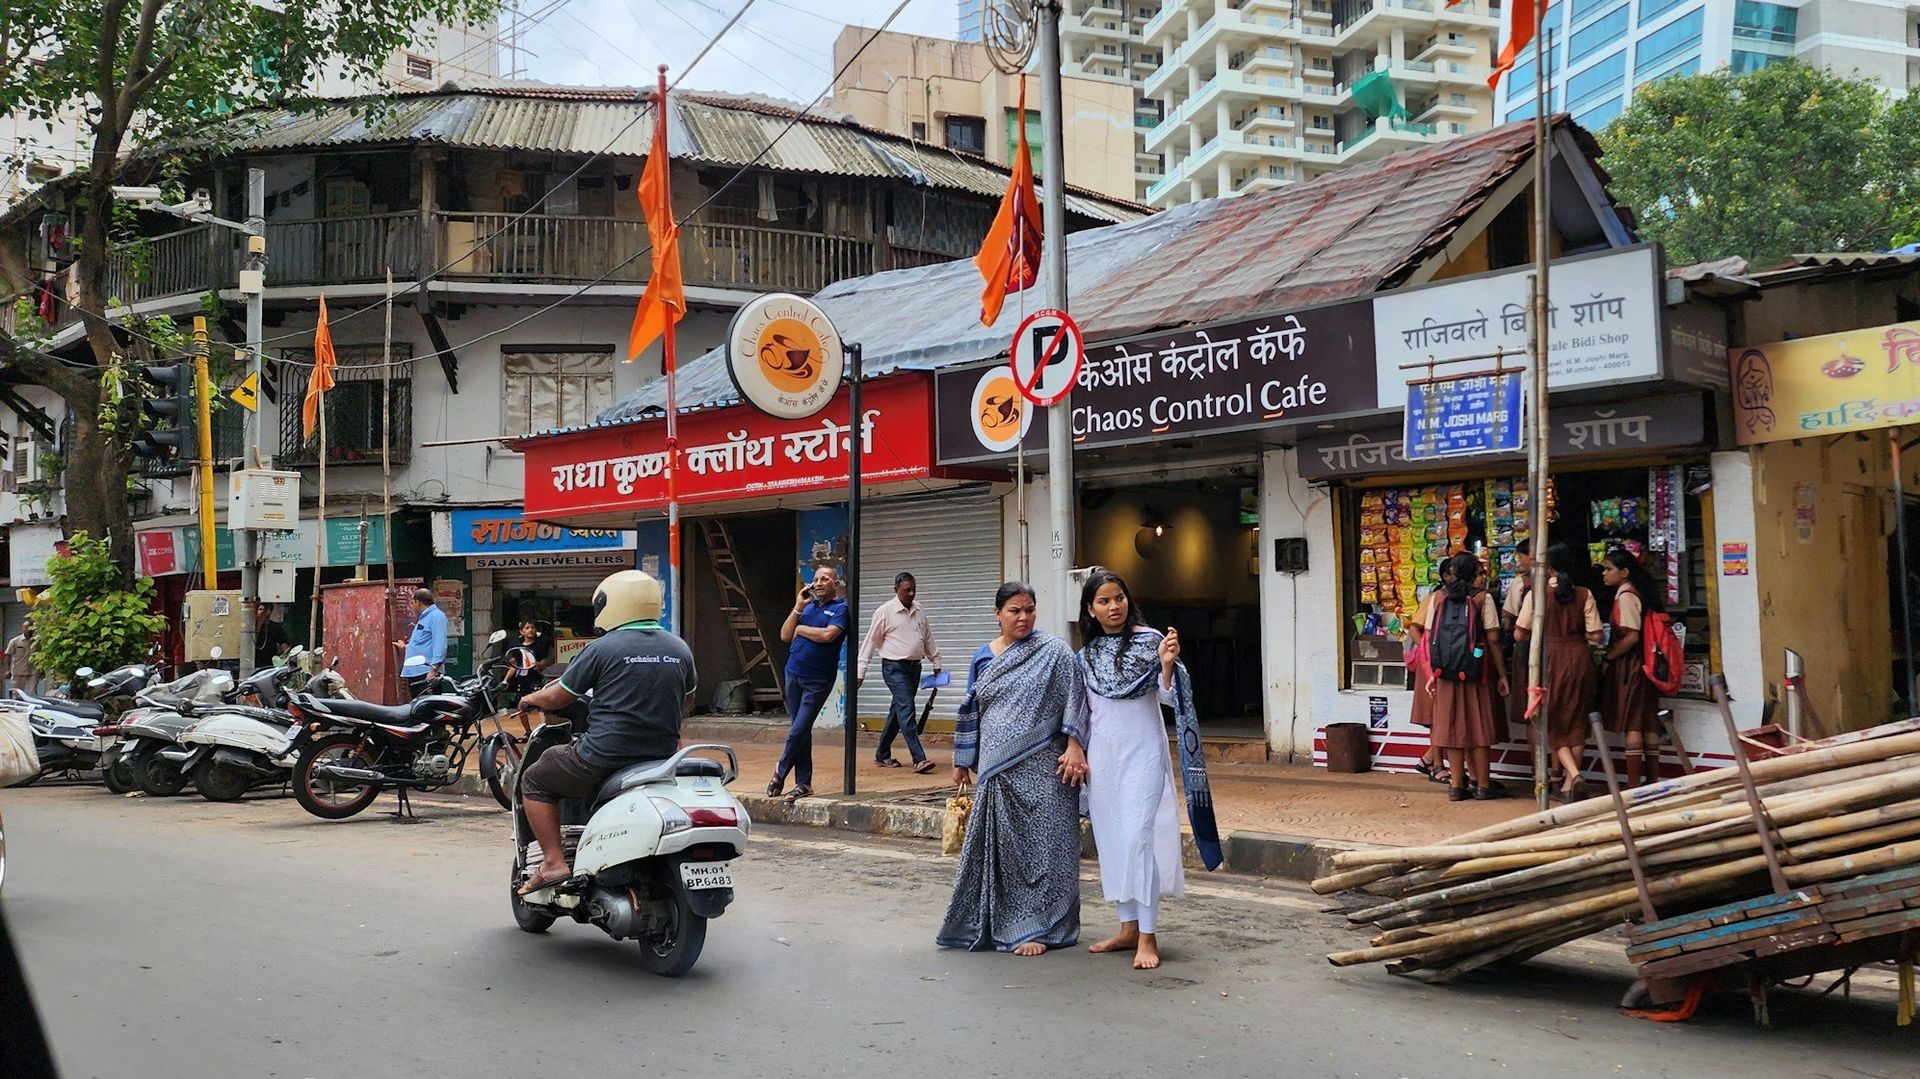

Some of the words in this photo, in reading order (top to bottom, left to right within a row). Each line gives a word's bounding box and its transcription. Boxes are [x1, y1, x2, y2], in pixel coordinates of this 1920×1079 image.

[1402, 309, 1489, 351] राजिवले
[1571, 292, 1626, 327] शॉप
[1158, 330, 1241, 380] कंट्रोल
[1247, 315, 1306, 366] कॅफे
[1572, 336, 1595, 349] Bidi
[1600, 333, 1629, 345] Shop
[1072, 404, 1143, 436] Chaos
[1150, 383, 1253, 426] Control
[1262, 374, 1327, 412] Cafe
[1444, 413, 1474, 427] JOSHI
[1475, 409, 1509, 422] MARG
[1563, 409, 1652, 450] शॉप
[551, 459, 607, 492] राधा
[685, 429, 775, 475] क्लॉथ
[477, 557, 529, 568] SAJAN
[532, 554, 625, 566] JEWELLERS
[623, 655, 661, 664] Technical
[663, 655, 681, 664] Crew
[691, 866, 724, 875] MH.01
[687, 876, 732, 888] BP.6483
